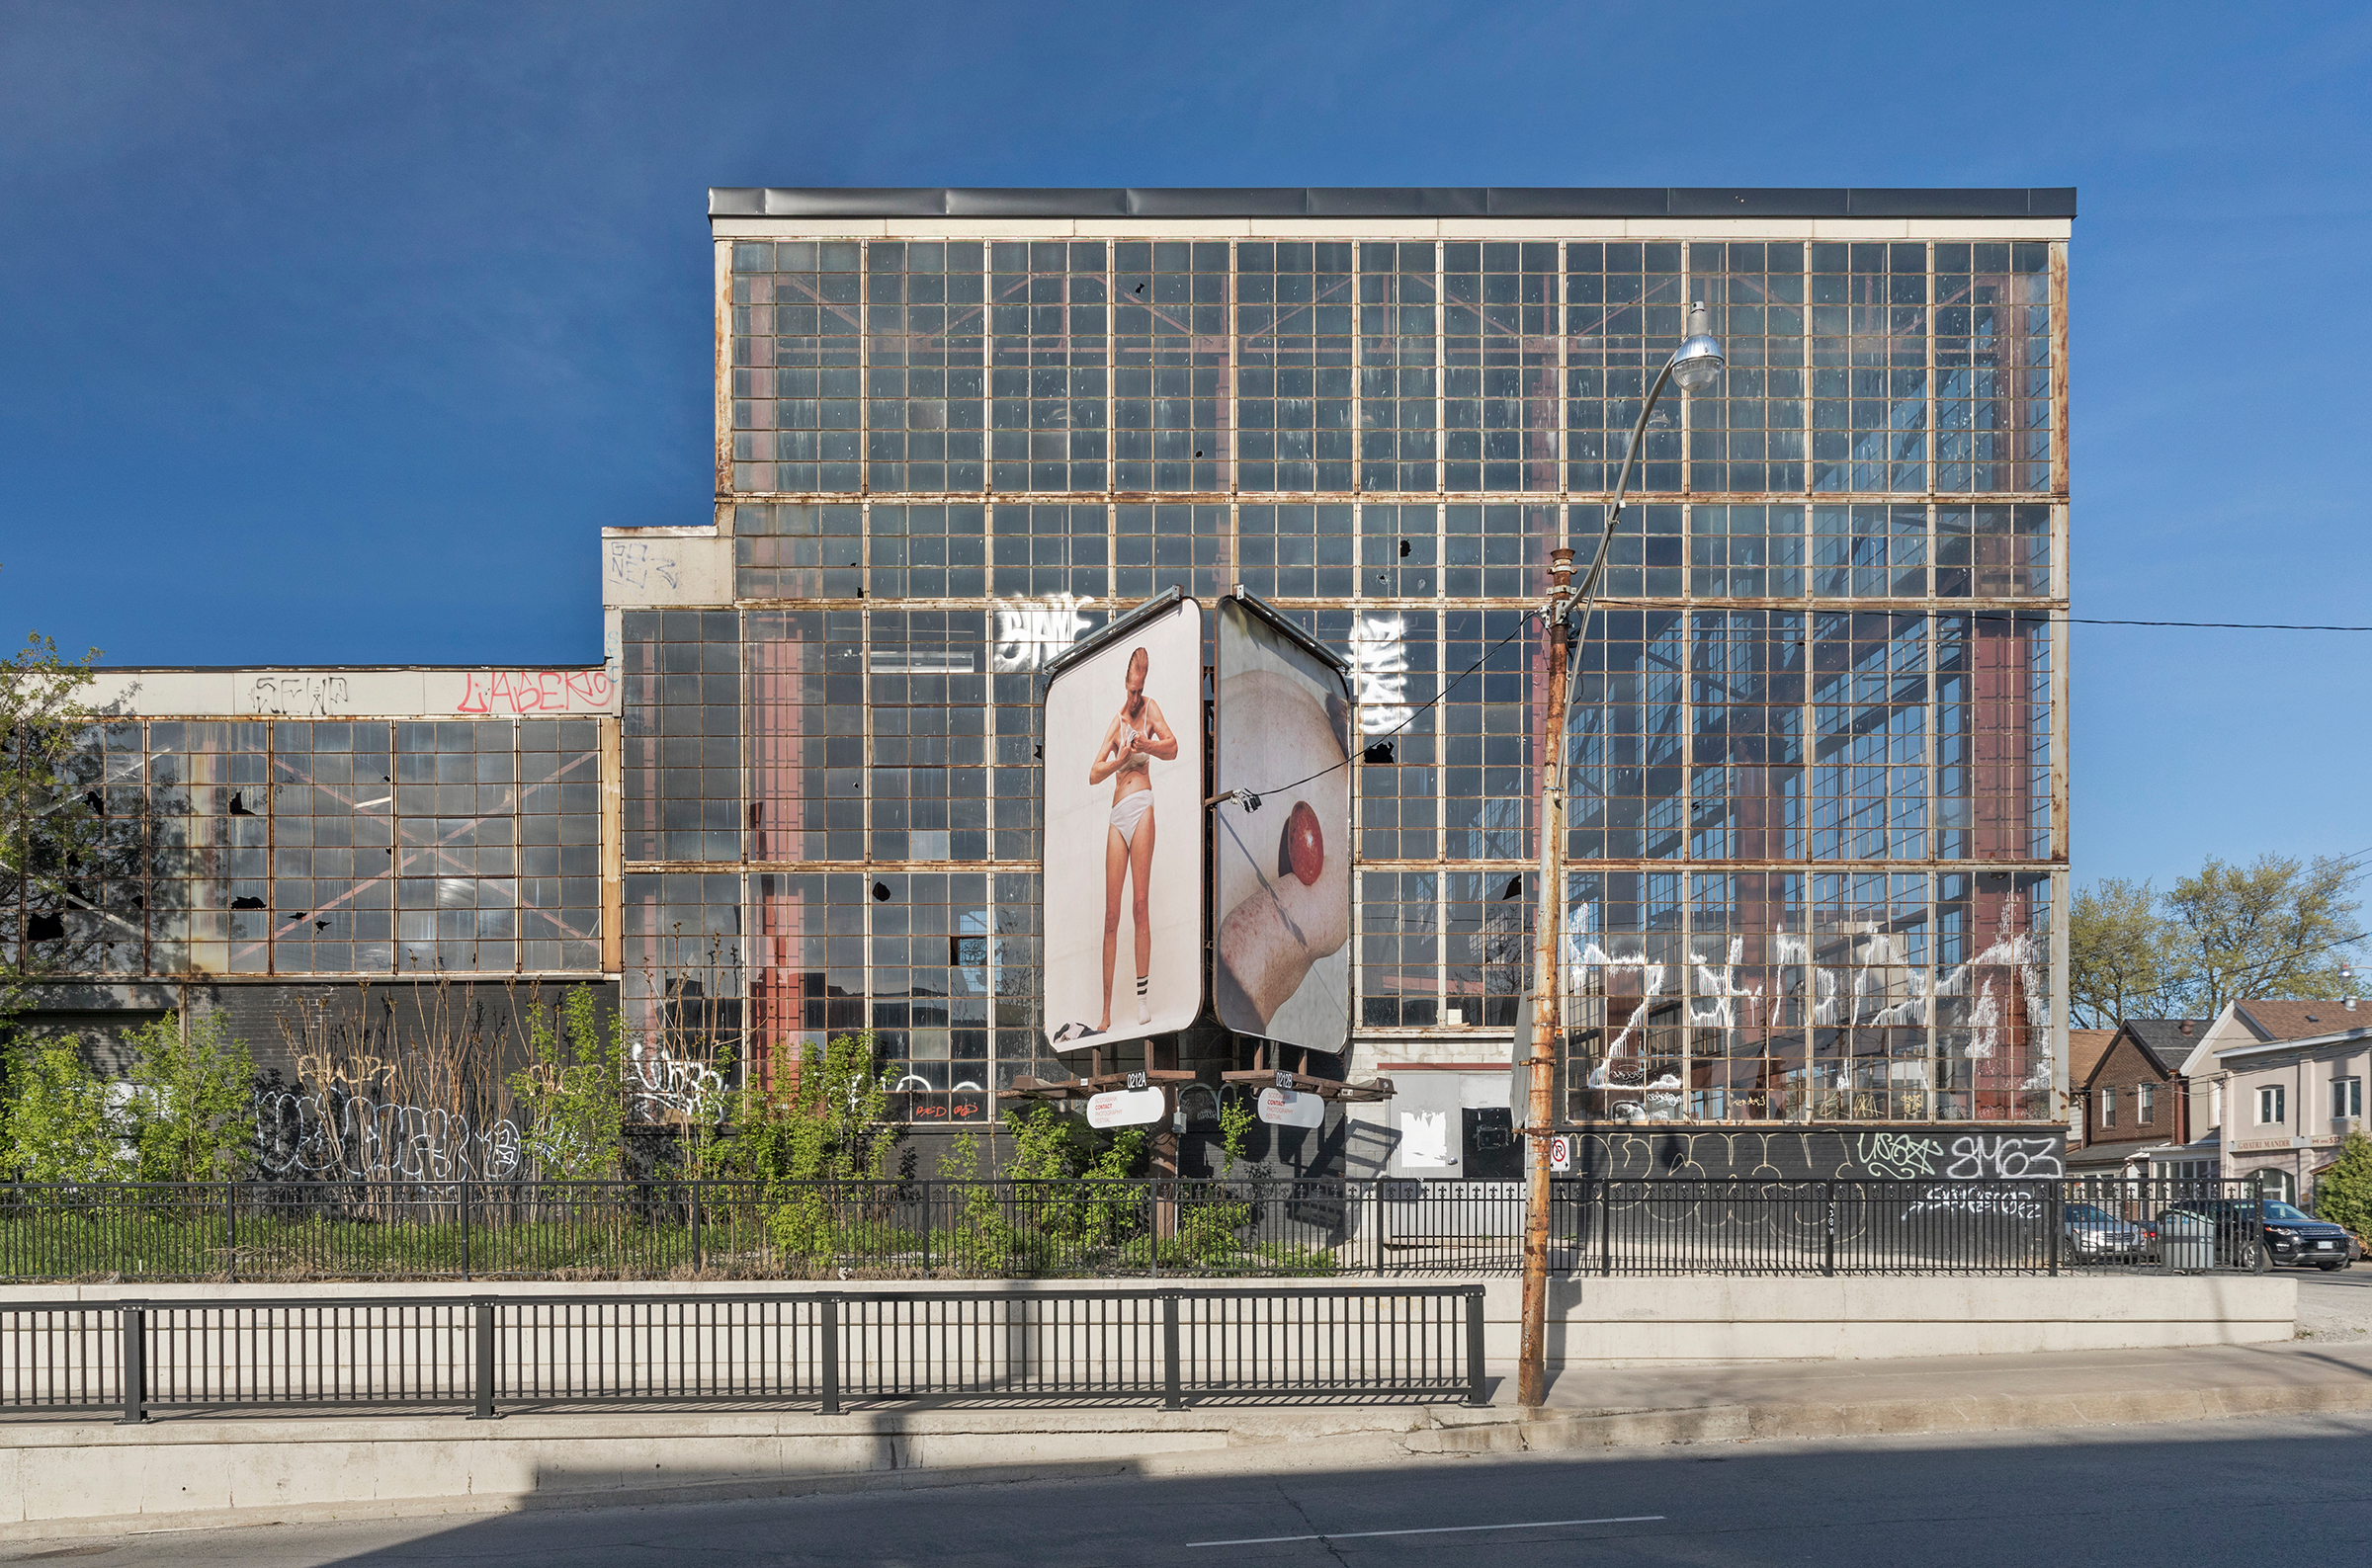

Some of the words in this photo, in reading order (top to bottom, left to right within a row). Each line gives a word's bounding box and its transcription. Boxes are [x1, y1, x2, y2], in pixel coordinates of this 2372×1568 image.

[1127, 1071, 1146, 1089] 0212A
[1276, 1071, 1293, 1089] 0212B
[1094, 1096, 1119, 1105] SCOTIABANK
[1094, 1109, 1124, 1117] PHOTOGRAPHY
[1266, 1106, 1294, 1114] PHOTOGRAPHY
